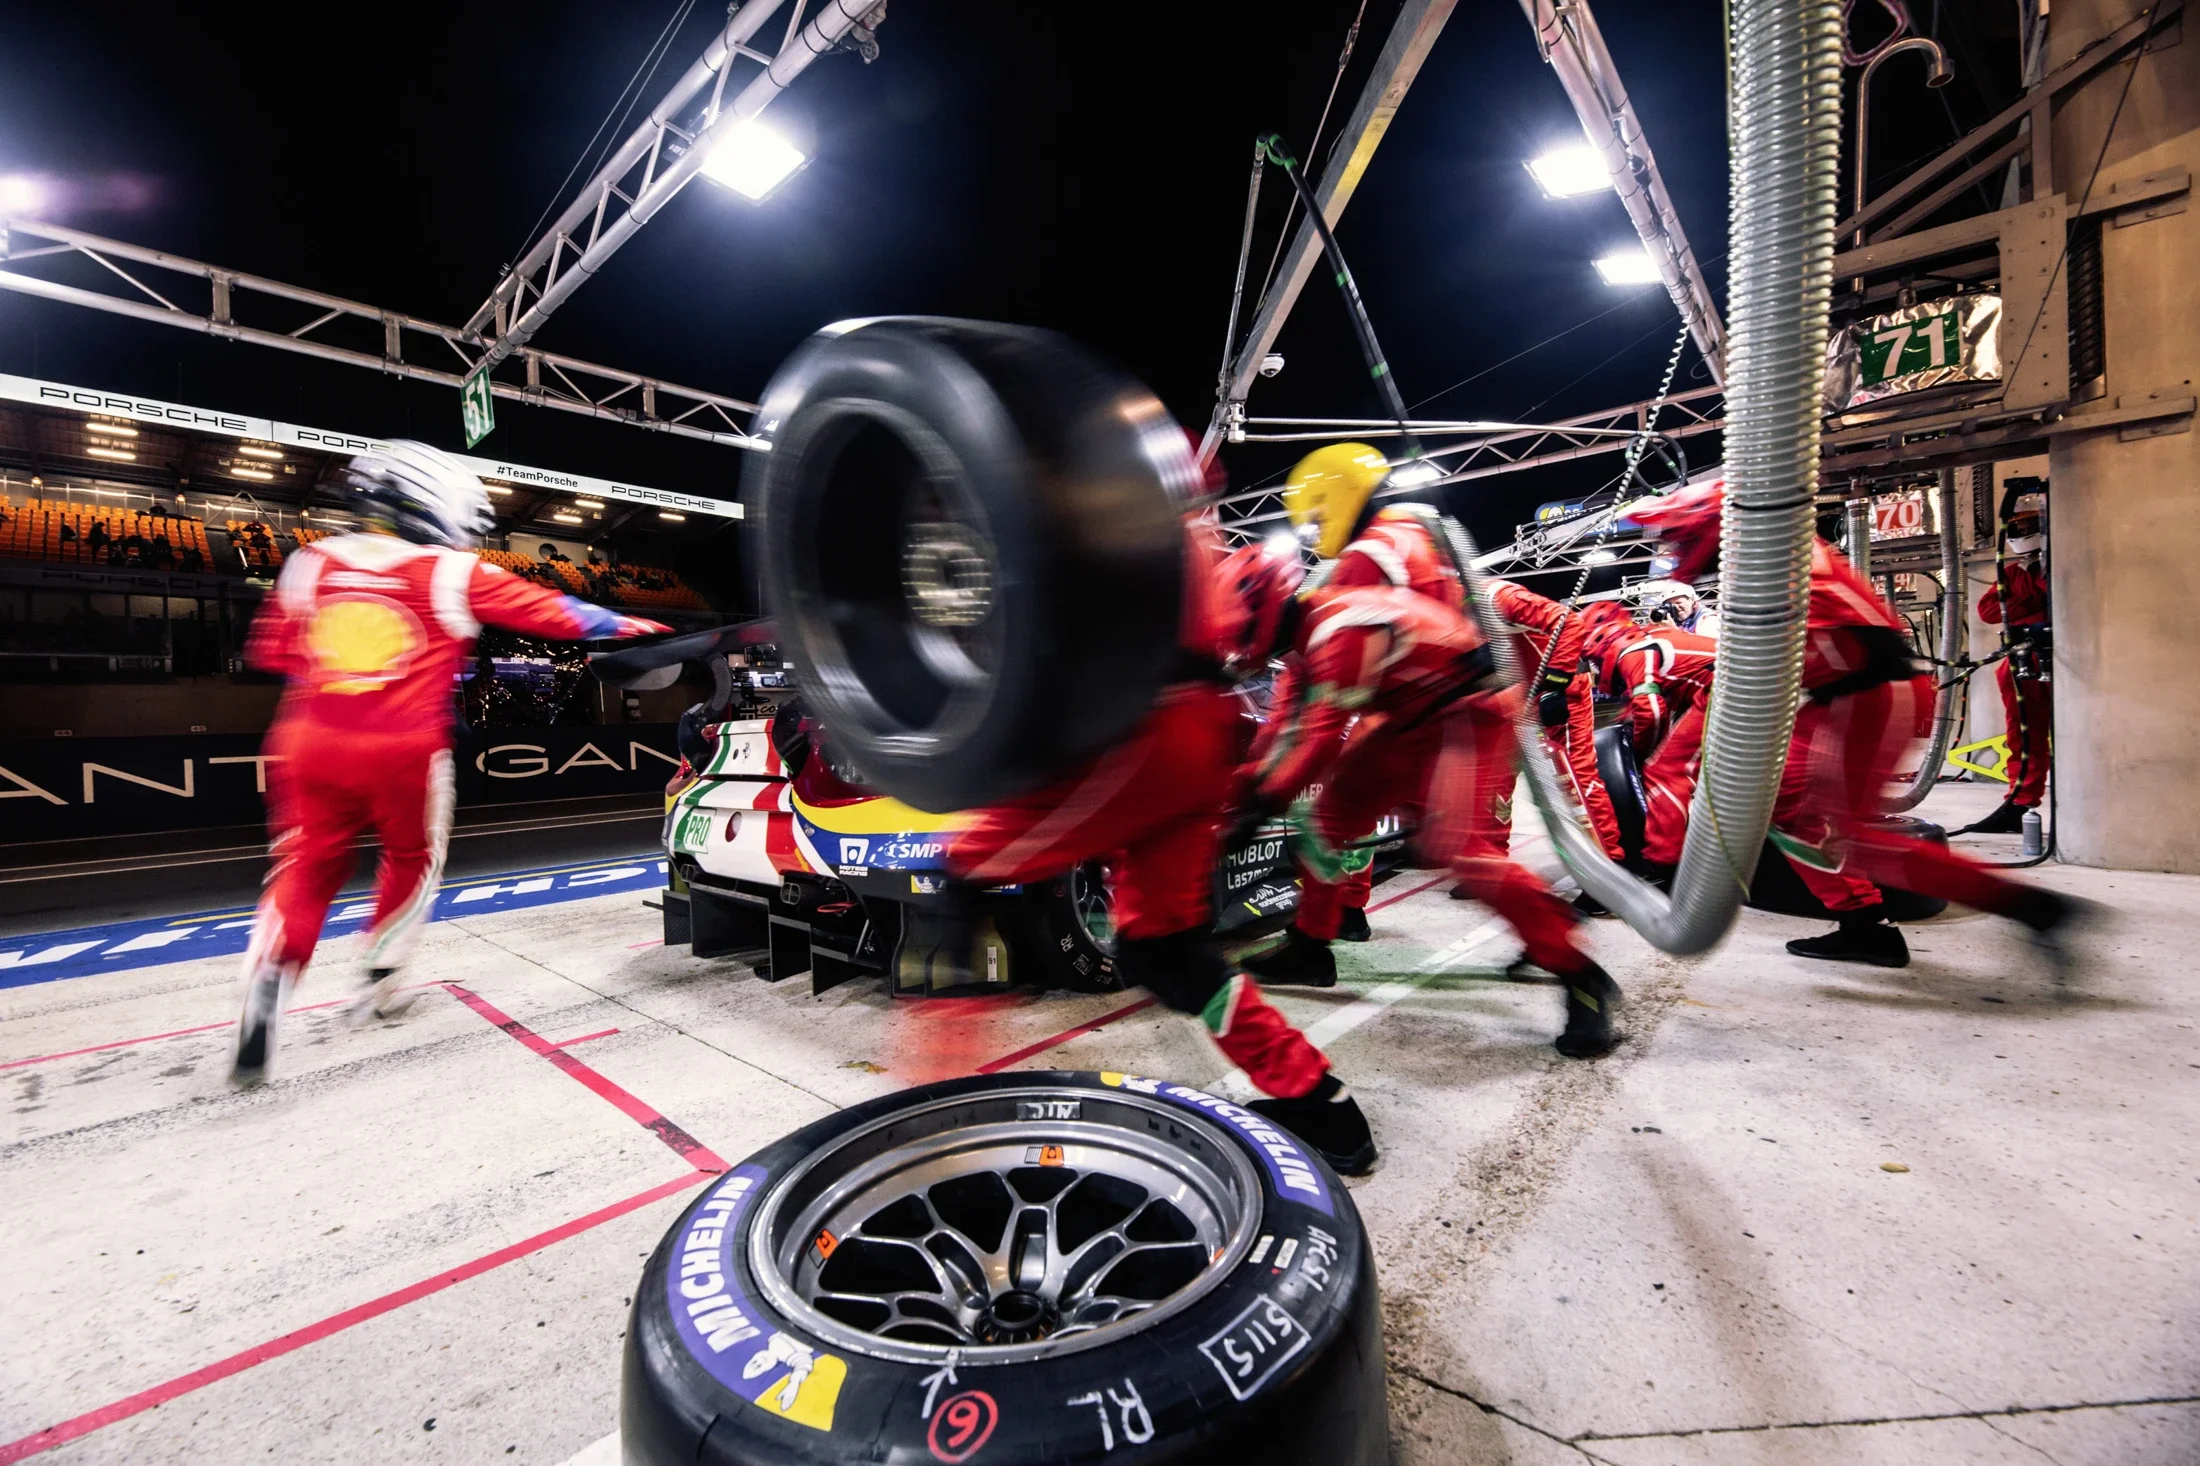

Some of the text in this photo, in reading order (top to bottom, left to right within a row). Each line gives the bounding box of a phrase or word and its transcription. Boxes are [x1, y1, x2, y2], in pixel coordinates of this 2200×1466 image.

[1874, 317, 1945, 379] 71
[40, 386, 247, 432] PORSCHE
[466, 372, 490, 440] 51
[298, 430, 394, 455] PORS
[496, 465, 579, 488] #TeamPorsche
[612, 485, 716, 511] PORSCHE
[1876, 502, 1920, 530] 70
[685, 815, 712, 847] PRO
[898, 843, 943, 858] SMP
[1165, 1086, 1320, 1196] MICHELIN
[680, 1176, 761, 1354] MICHELIN
[1066, 1377, 1155, 1451] RL
